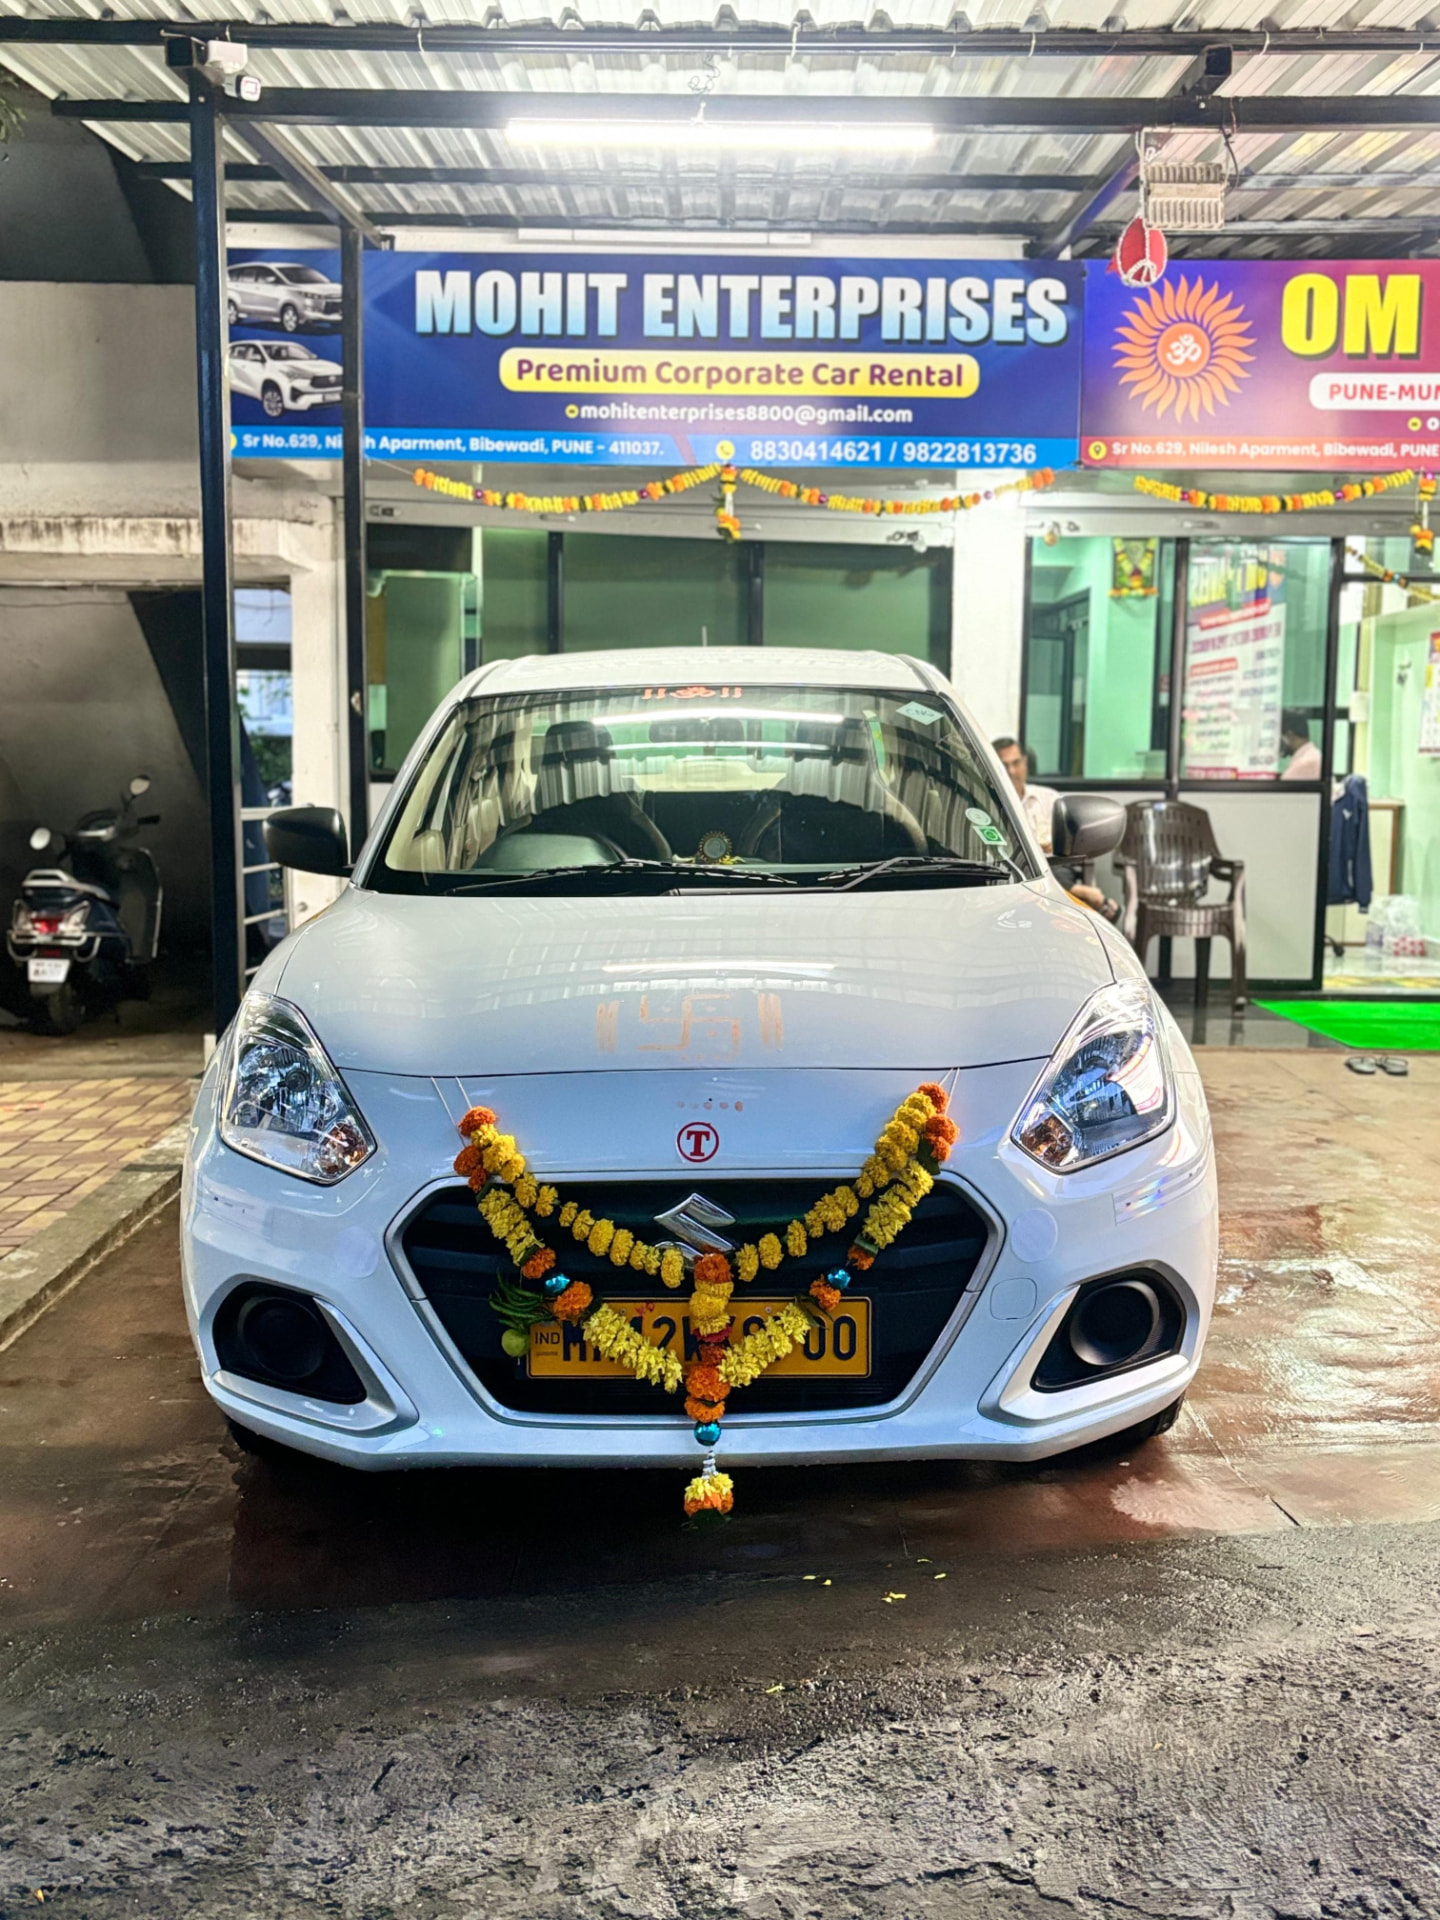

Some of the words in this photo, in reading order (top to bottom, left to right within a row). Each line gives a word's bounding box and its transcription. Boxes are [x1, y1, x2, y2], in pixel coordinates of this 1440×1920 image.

[415, 269, 628, 337] MOHIT
[643, 273, 1069, 346] ENTERPRISES
[1281, 272, 1421, 356] OM
[517, 358, 647, 382] Premium
[655, 361, 804, 389] Corporate
[812, 363, 860, 386] Car
[869, 364, 963, 387] Rental
[580, 401, 913, 425] mohitenterprises8800@gmail.com
[243, 434, 260, 449] Sr
[263, 434, 321, 450] No.629,
[325, 434, 376, 450] Nih
[379, 436, 465, 454] Aparment,
[469, 437, 549, 455] Bibewadi,
[552, 439, 594, 454] PUNE
[608, 441, 664, 456] 411037.
[751, 440, 881, 462] 8830414621
[889, 441, 897, 462] /
[903, 442, 1037, 464] 9822813736
[1112, 442, 1128, 456] Sr
[1131, 442, 1186, 457] No.629,
[1190, 442, 1234, 456] Nilesh
[1239, 442, 1321, 459] Aparment,
[1324, 443, 1397, 459] Bibewadi,
[1401, 444, 1440, 457] PUNE
[686, 1130, 710, 1157] T
[535, 1331, 560, 1345] IND
